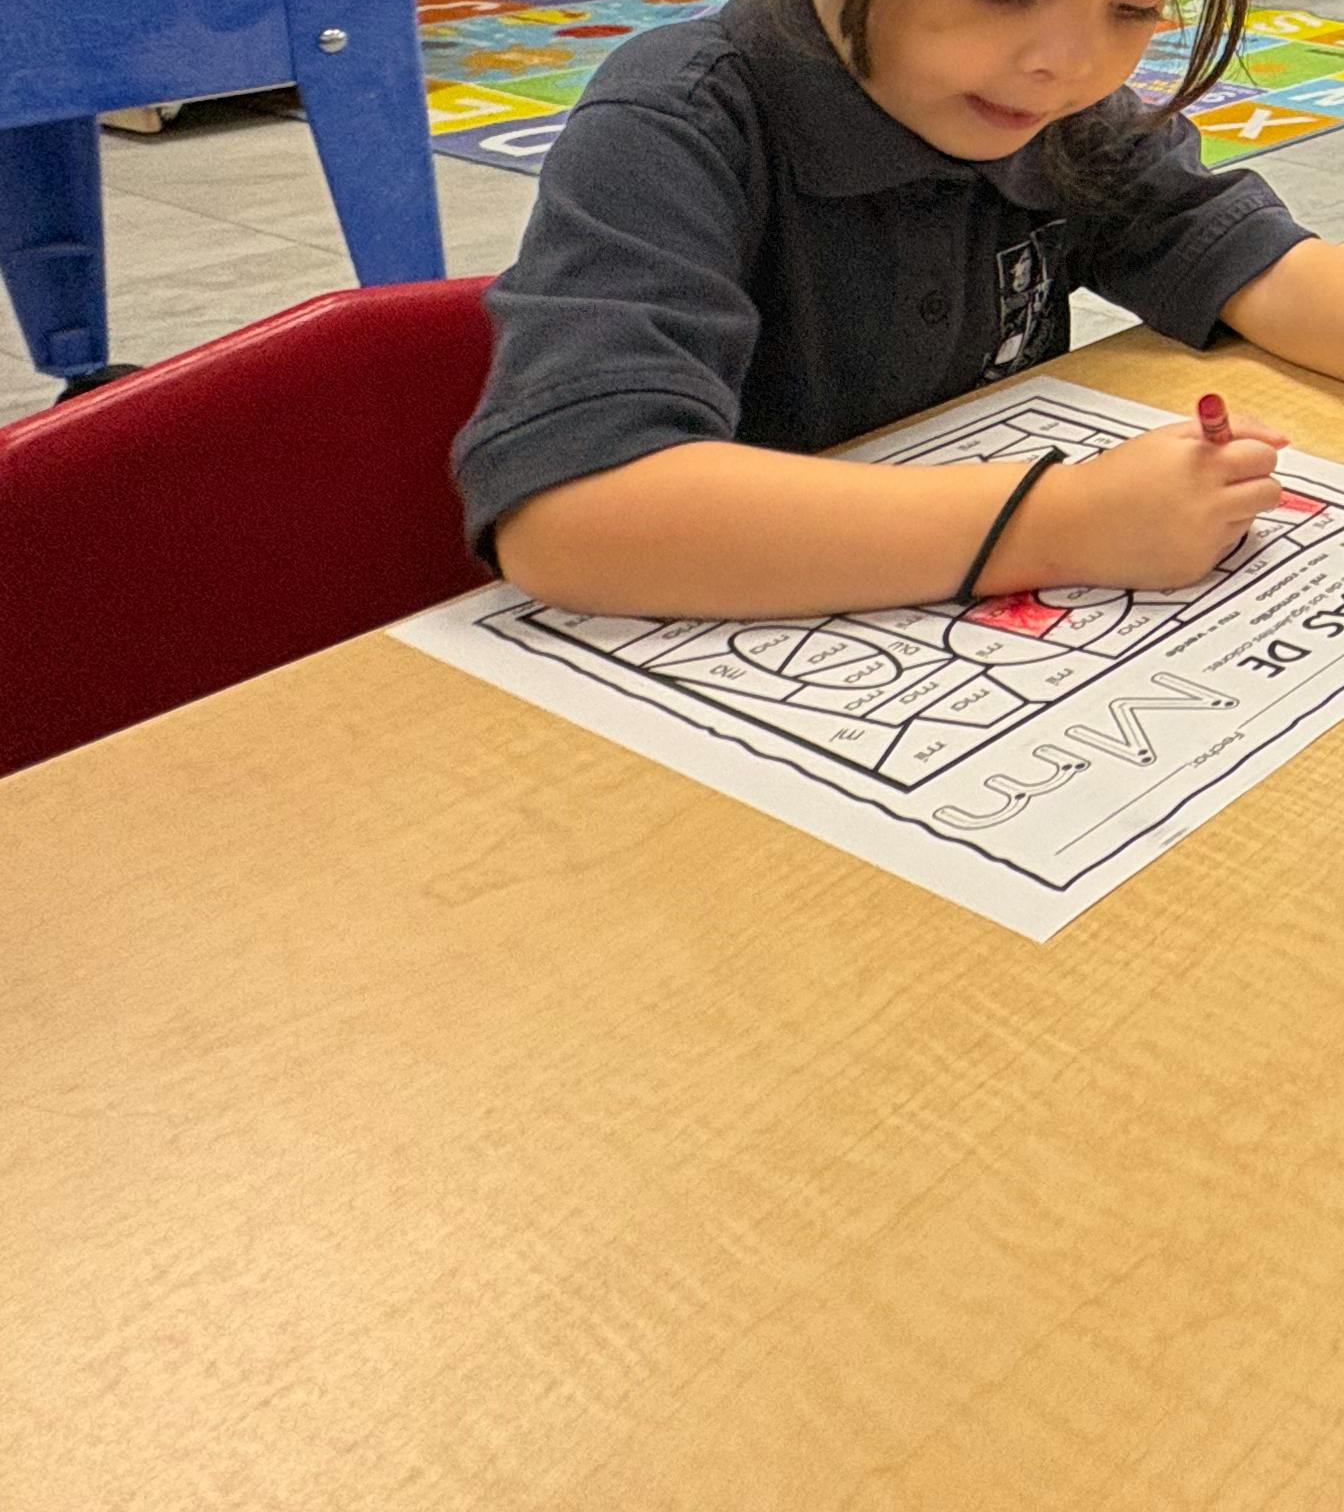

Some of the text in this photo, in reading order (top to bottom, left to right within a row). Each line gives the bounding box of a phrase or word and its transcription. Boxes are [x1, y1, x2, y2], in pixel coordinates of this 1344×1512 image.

[1201, 108, 1317, 140] X
[807, 643, 848, 665] ma
[1236, 638, 1309, 679] DE
[843, 661, 884, 684] ma
[843, 689, 884, 711] ma
[899, 681, 938, 705] ma
[950, 688, 990, 712] ma
[828, 728, 865, 742] mi
[913, 740, 946, 763] mi
[932, 670, 1242, 833] Mm
[1186, 729, 1246, 771] Fecha:
